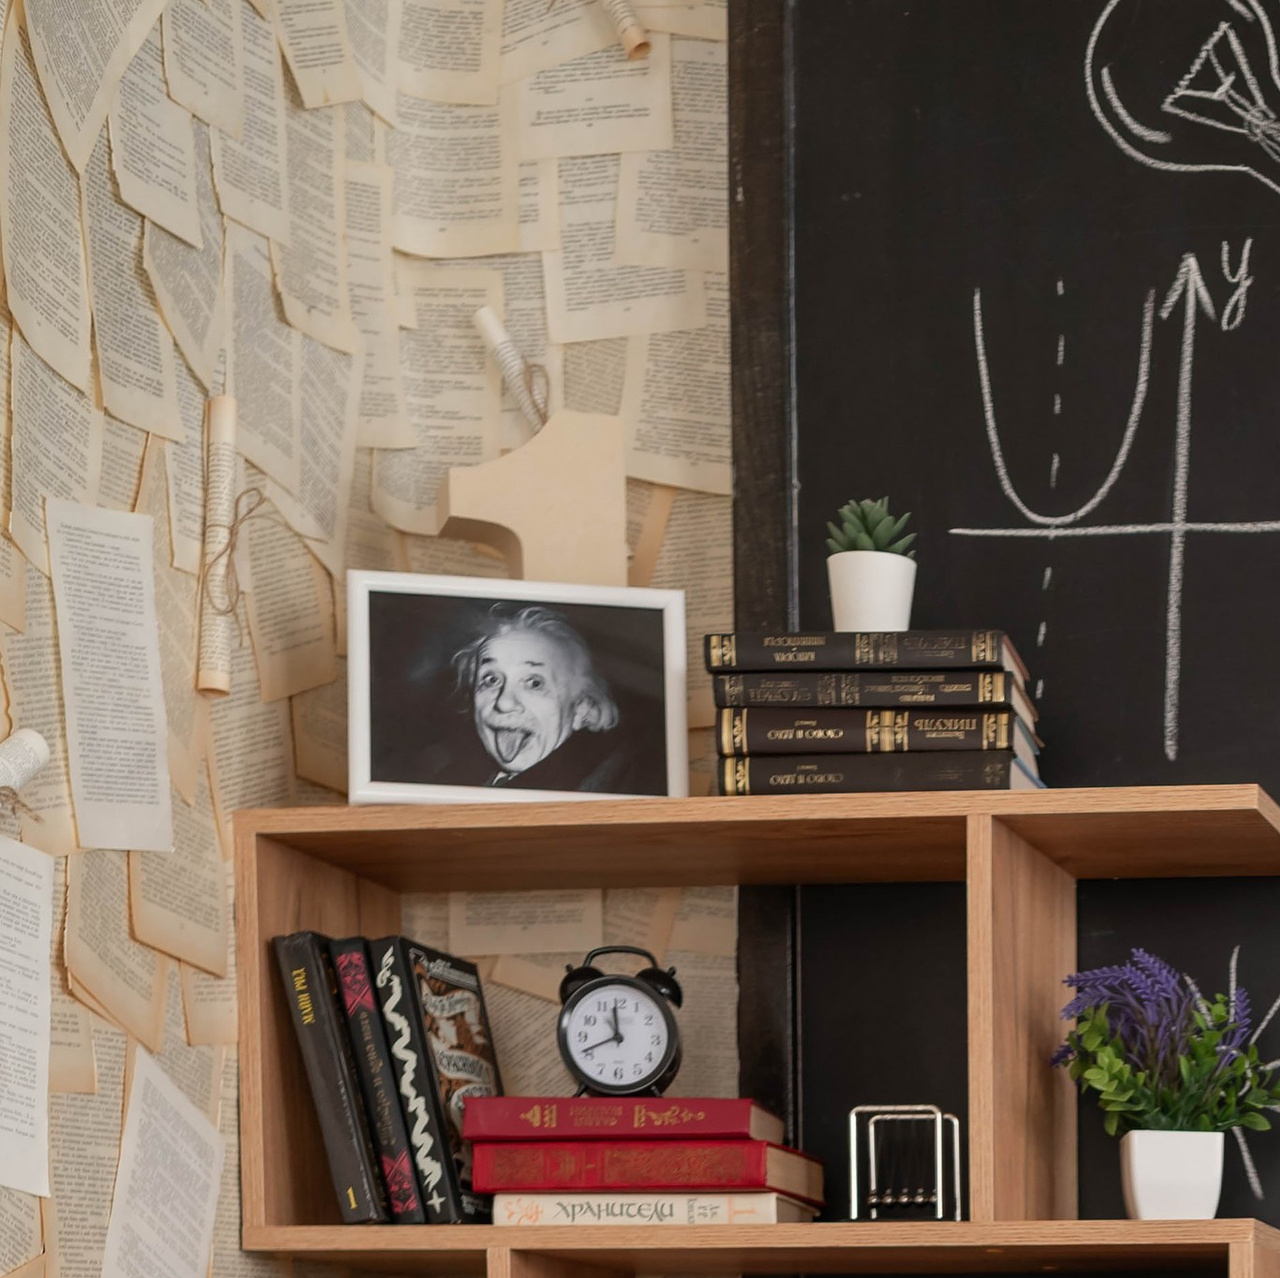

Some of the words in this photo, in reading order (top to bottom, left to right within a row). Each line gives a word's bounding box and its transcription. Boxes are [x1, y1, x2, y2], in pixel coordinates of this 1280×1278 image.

[1220, 237, 1253, 331] y
[914, 718, 977, 731] ПИКУЛЬ
[613, 1067, 623, 1080] 6
[345, 1187, 359, 1210] 1
[555, 1199, 675, 1224] ХРАНИТЕЛИ
